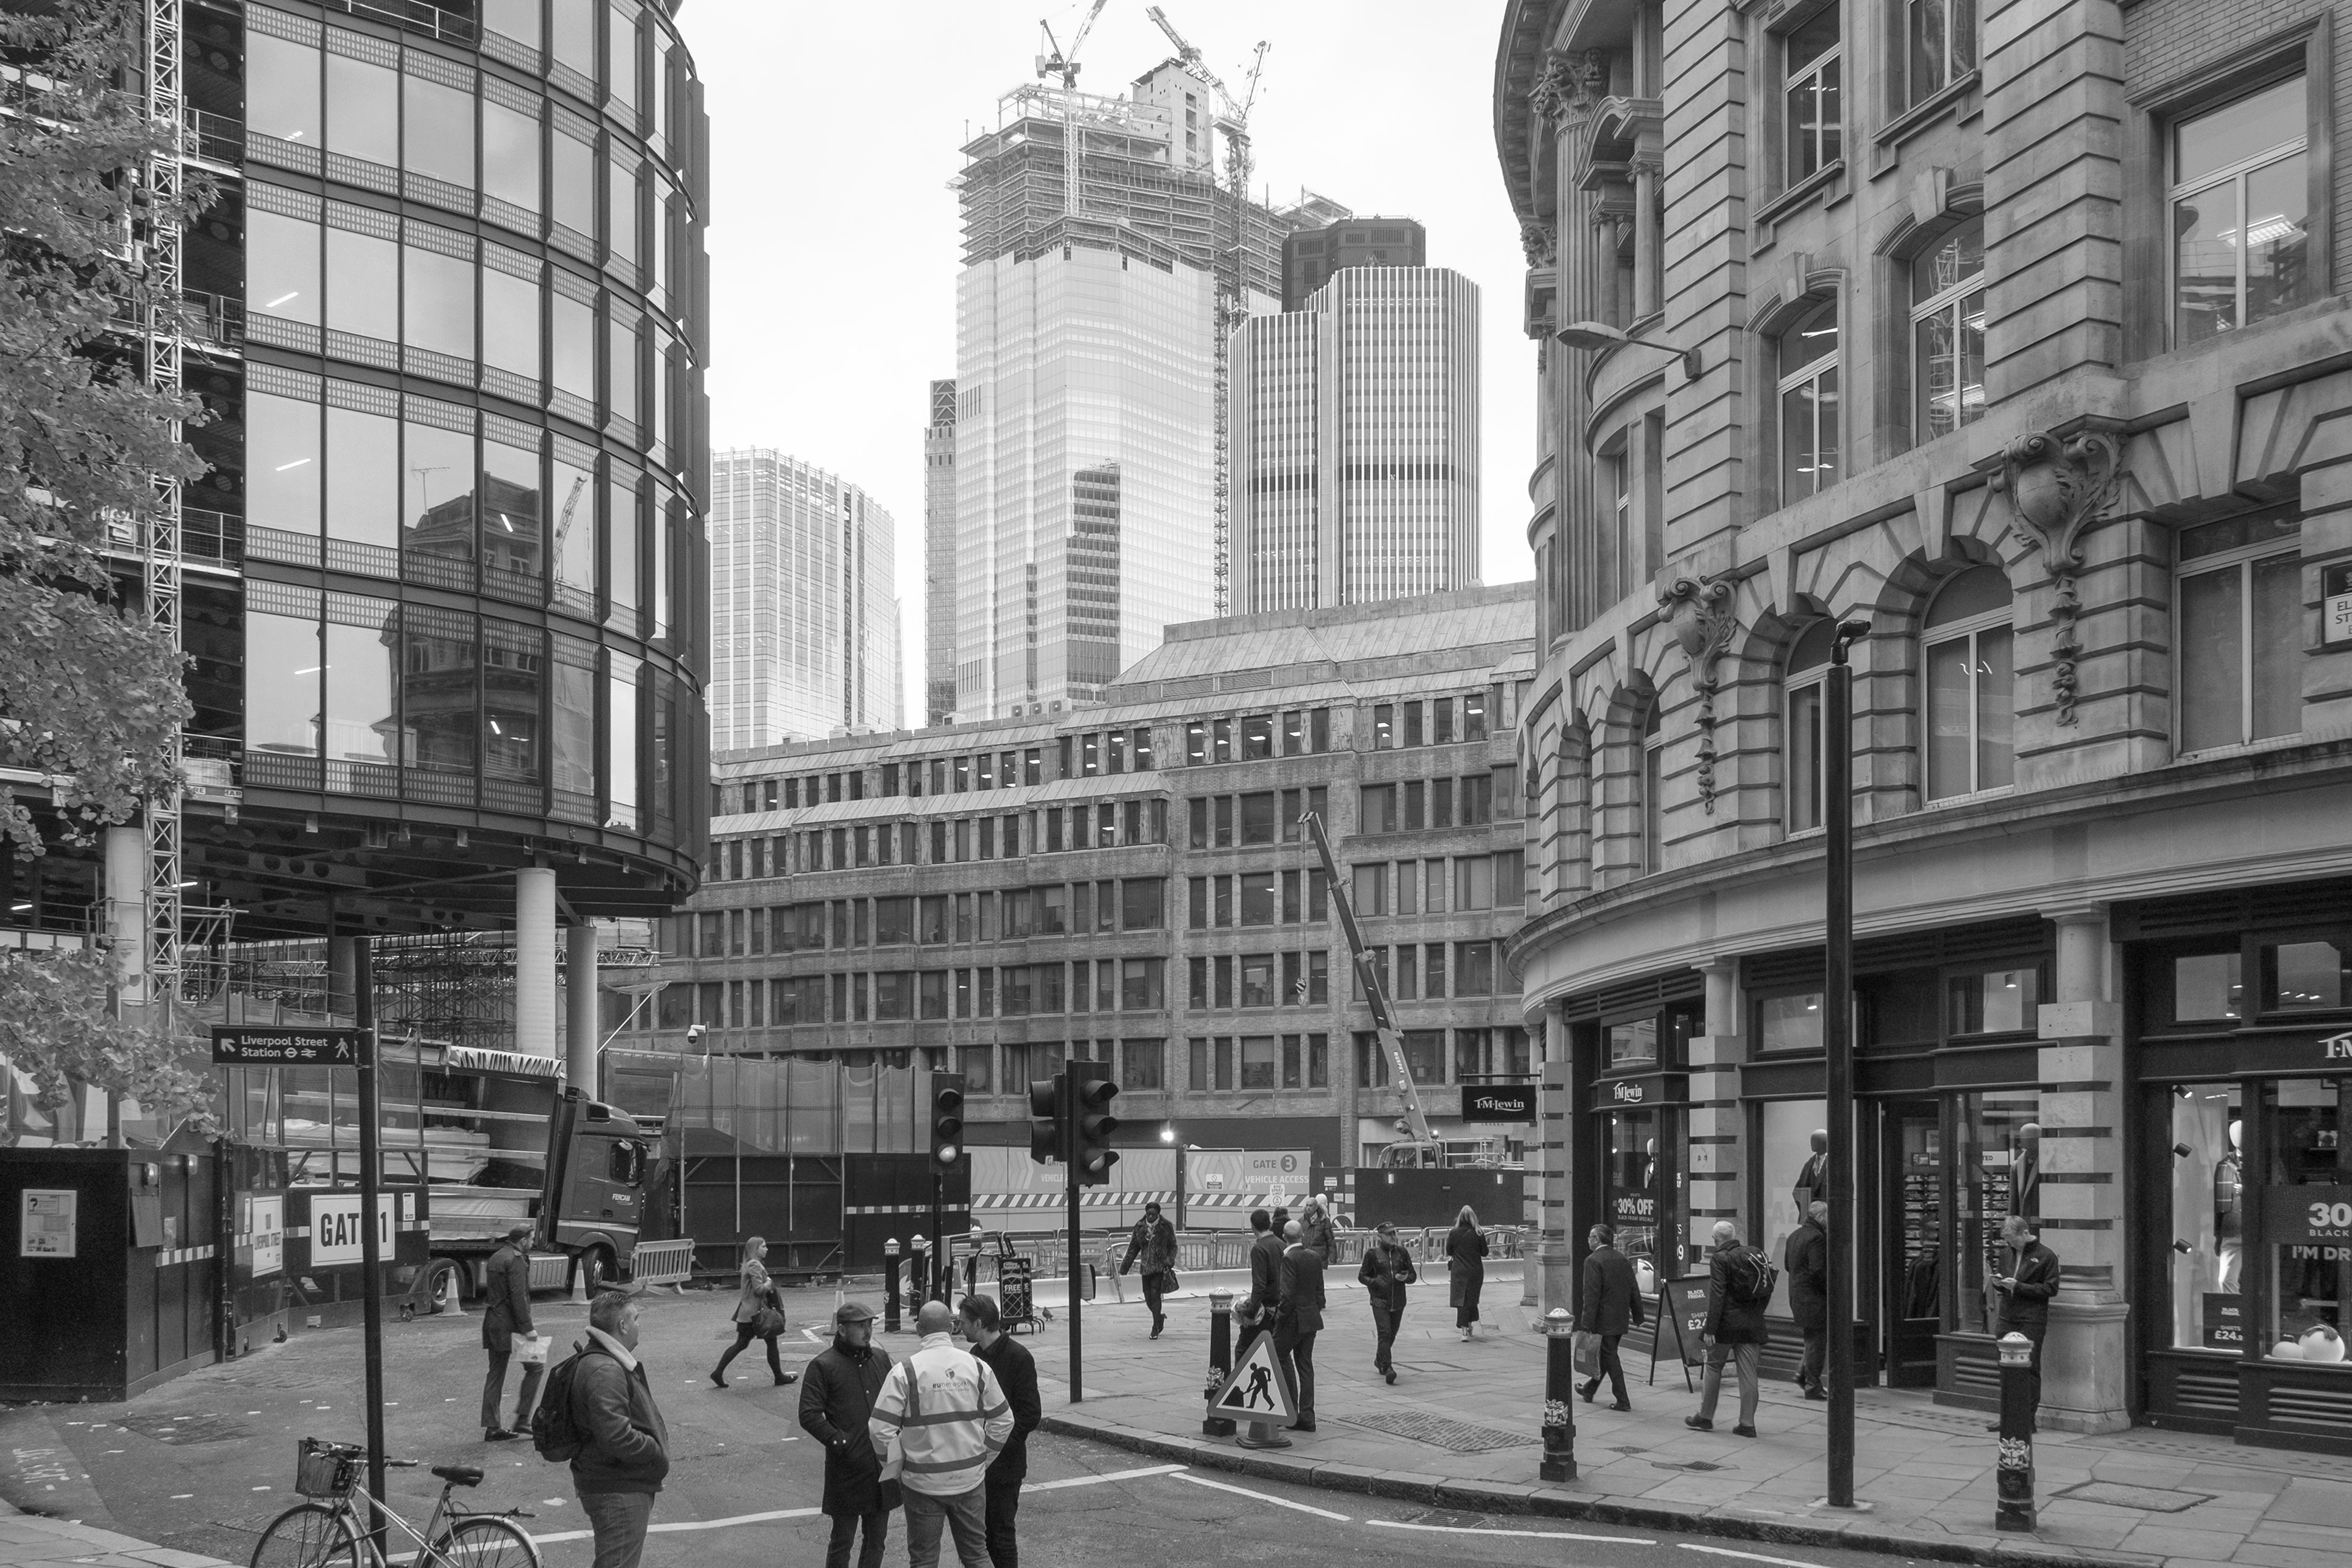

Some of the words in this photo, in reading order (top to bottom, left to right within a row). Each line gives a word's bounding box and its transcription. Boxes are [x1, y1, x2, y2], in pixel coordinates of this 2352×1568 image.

[2337, 601, 2352, 611] EL
[2336, 612, 2352, 624] ST
[241, 1035, 291, 1047] Liverpool
[295, 1036, 328, 1046] Street
[241, 1047, 281, 1057] Station
[1393, 1051, 1405, 1073] MURPHY
[1253, 1160, 1276, 1169] GATE
[1285, 1156, 1293, 1171] 3
[1041, 1174, 1063, 1182] VEHICLE
[1618, 1198, 1636, 1214] 30%
[1637, 1198, 1653, 1215] OFF
[321, 1212, 359, 1247] GAT
[380, 1211, 387, 1243] 1
[2324, 1247, 2352, 1261] DR
[932, 1379, 969, 1388] eunetwork
